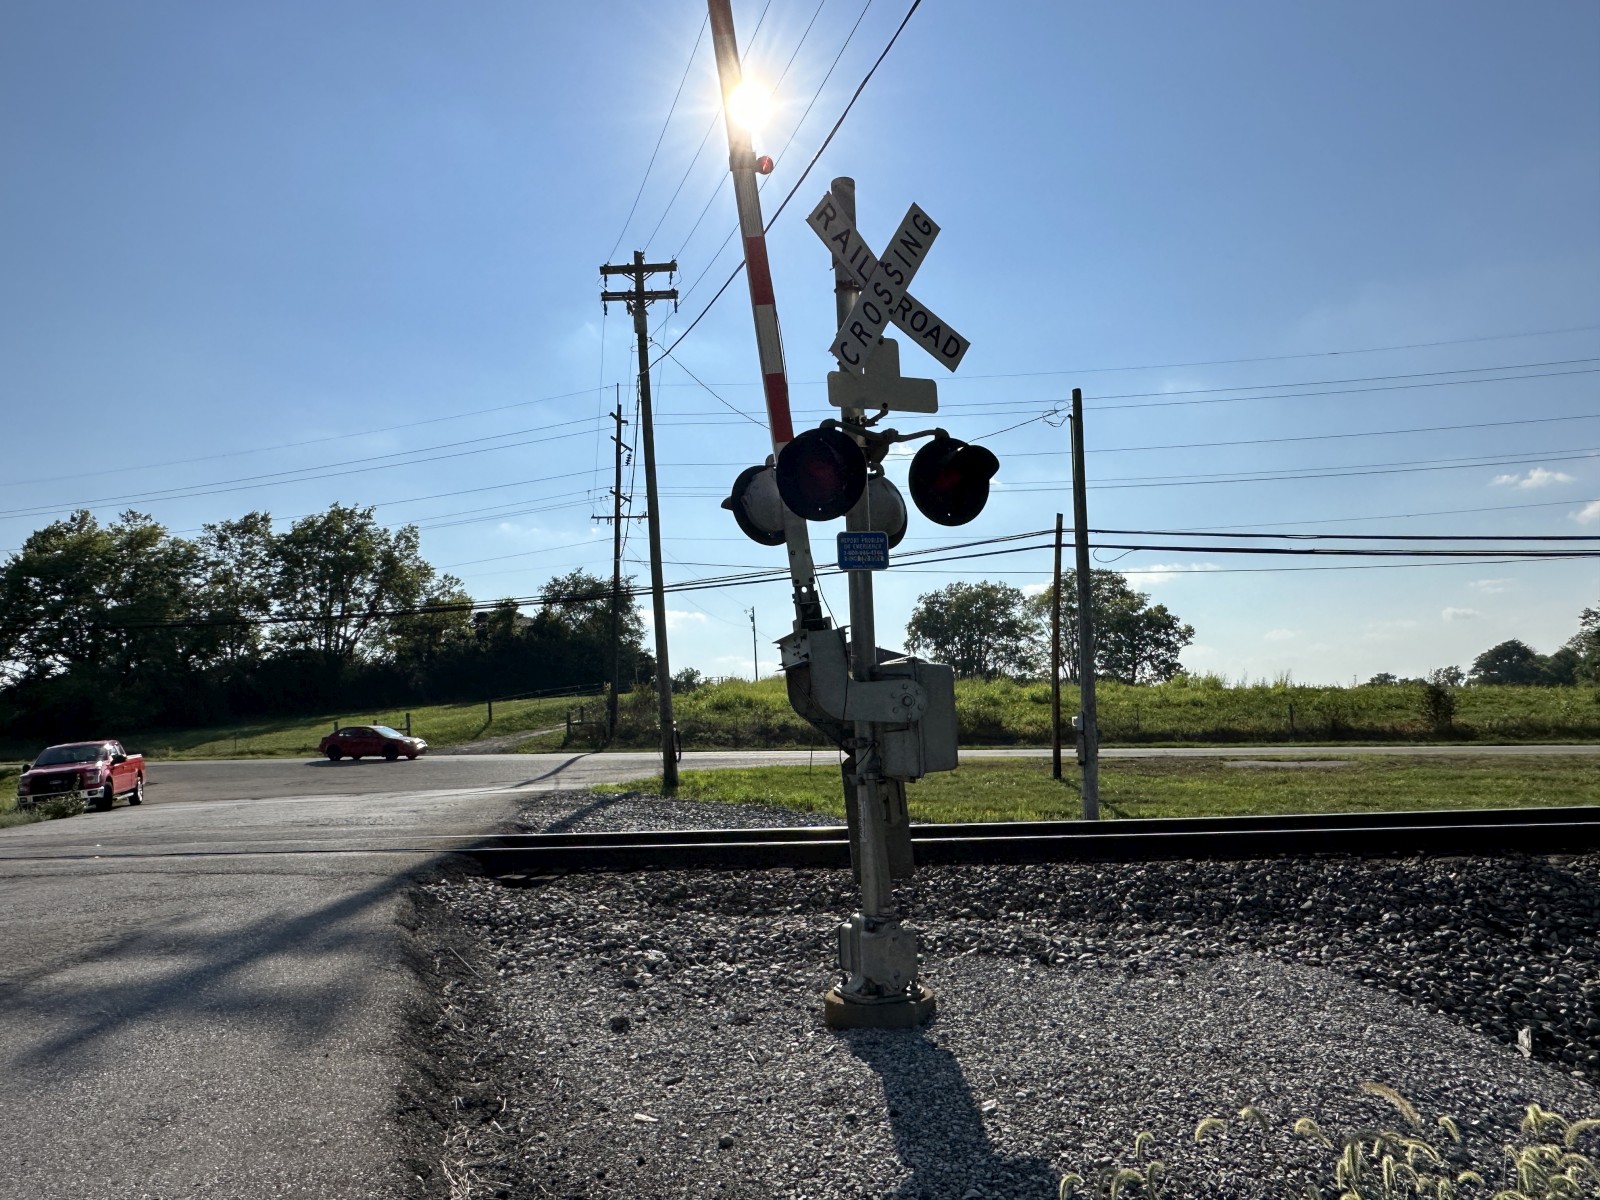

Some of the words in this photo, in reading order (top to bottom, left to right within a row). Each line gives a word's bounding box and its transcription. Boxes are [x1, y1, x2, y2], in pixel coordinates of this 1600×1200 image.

[816, 202, 869, 282] RAIL
[893, 297, 961, 358] ROAD
[840, 213, 932, 366] CROSSING
